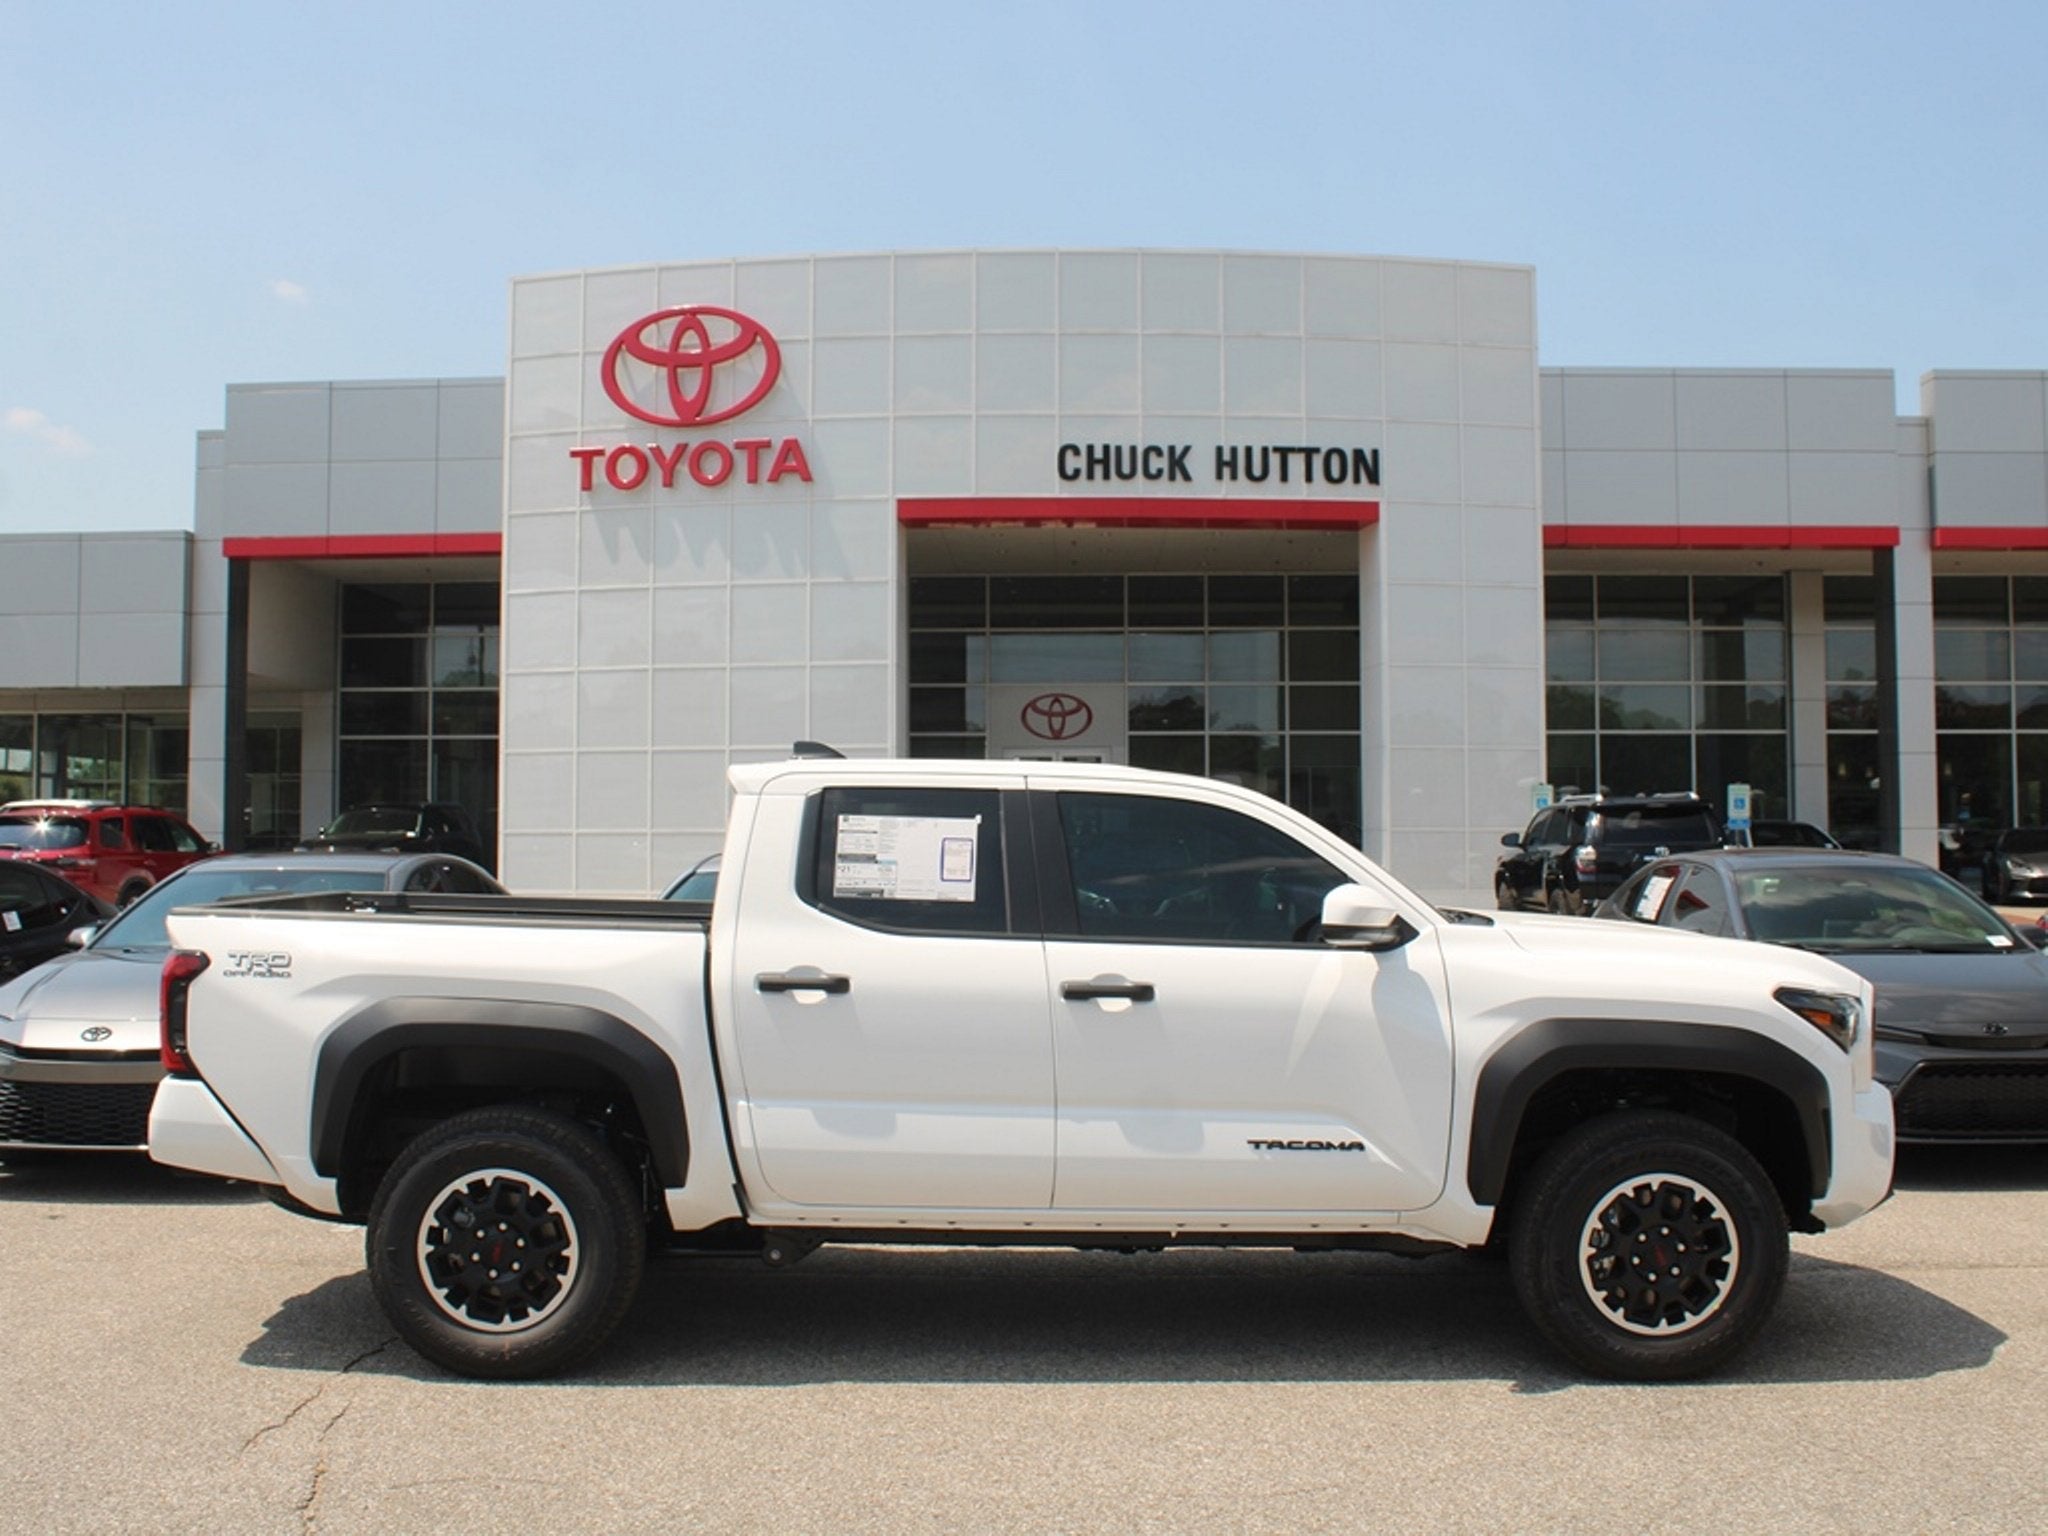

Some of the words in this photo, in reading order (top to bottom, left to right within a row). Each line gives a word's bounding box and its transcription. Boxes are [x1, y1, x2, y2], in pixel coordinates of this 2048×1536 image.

[570, 438, 813, 492] TOYOTA
[1057, 443, 1193, 483] CHUCK
[1214, 445, 1381, 487] HUTTON
[228, 952, 292, 972] TRD
[223, 970, 250, 978] OFF
[1247, 1140, 1366, 1152] TACOMA
